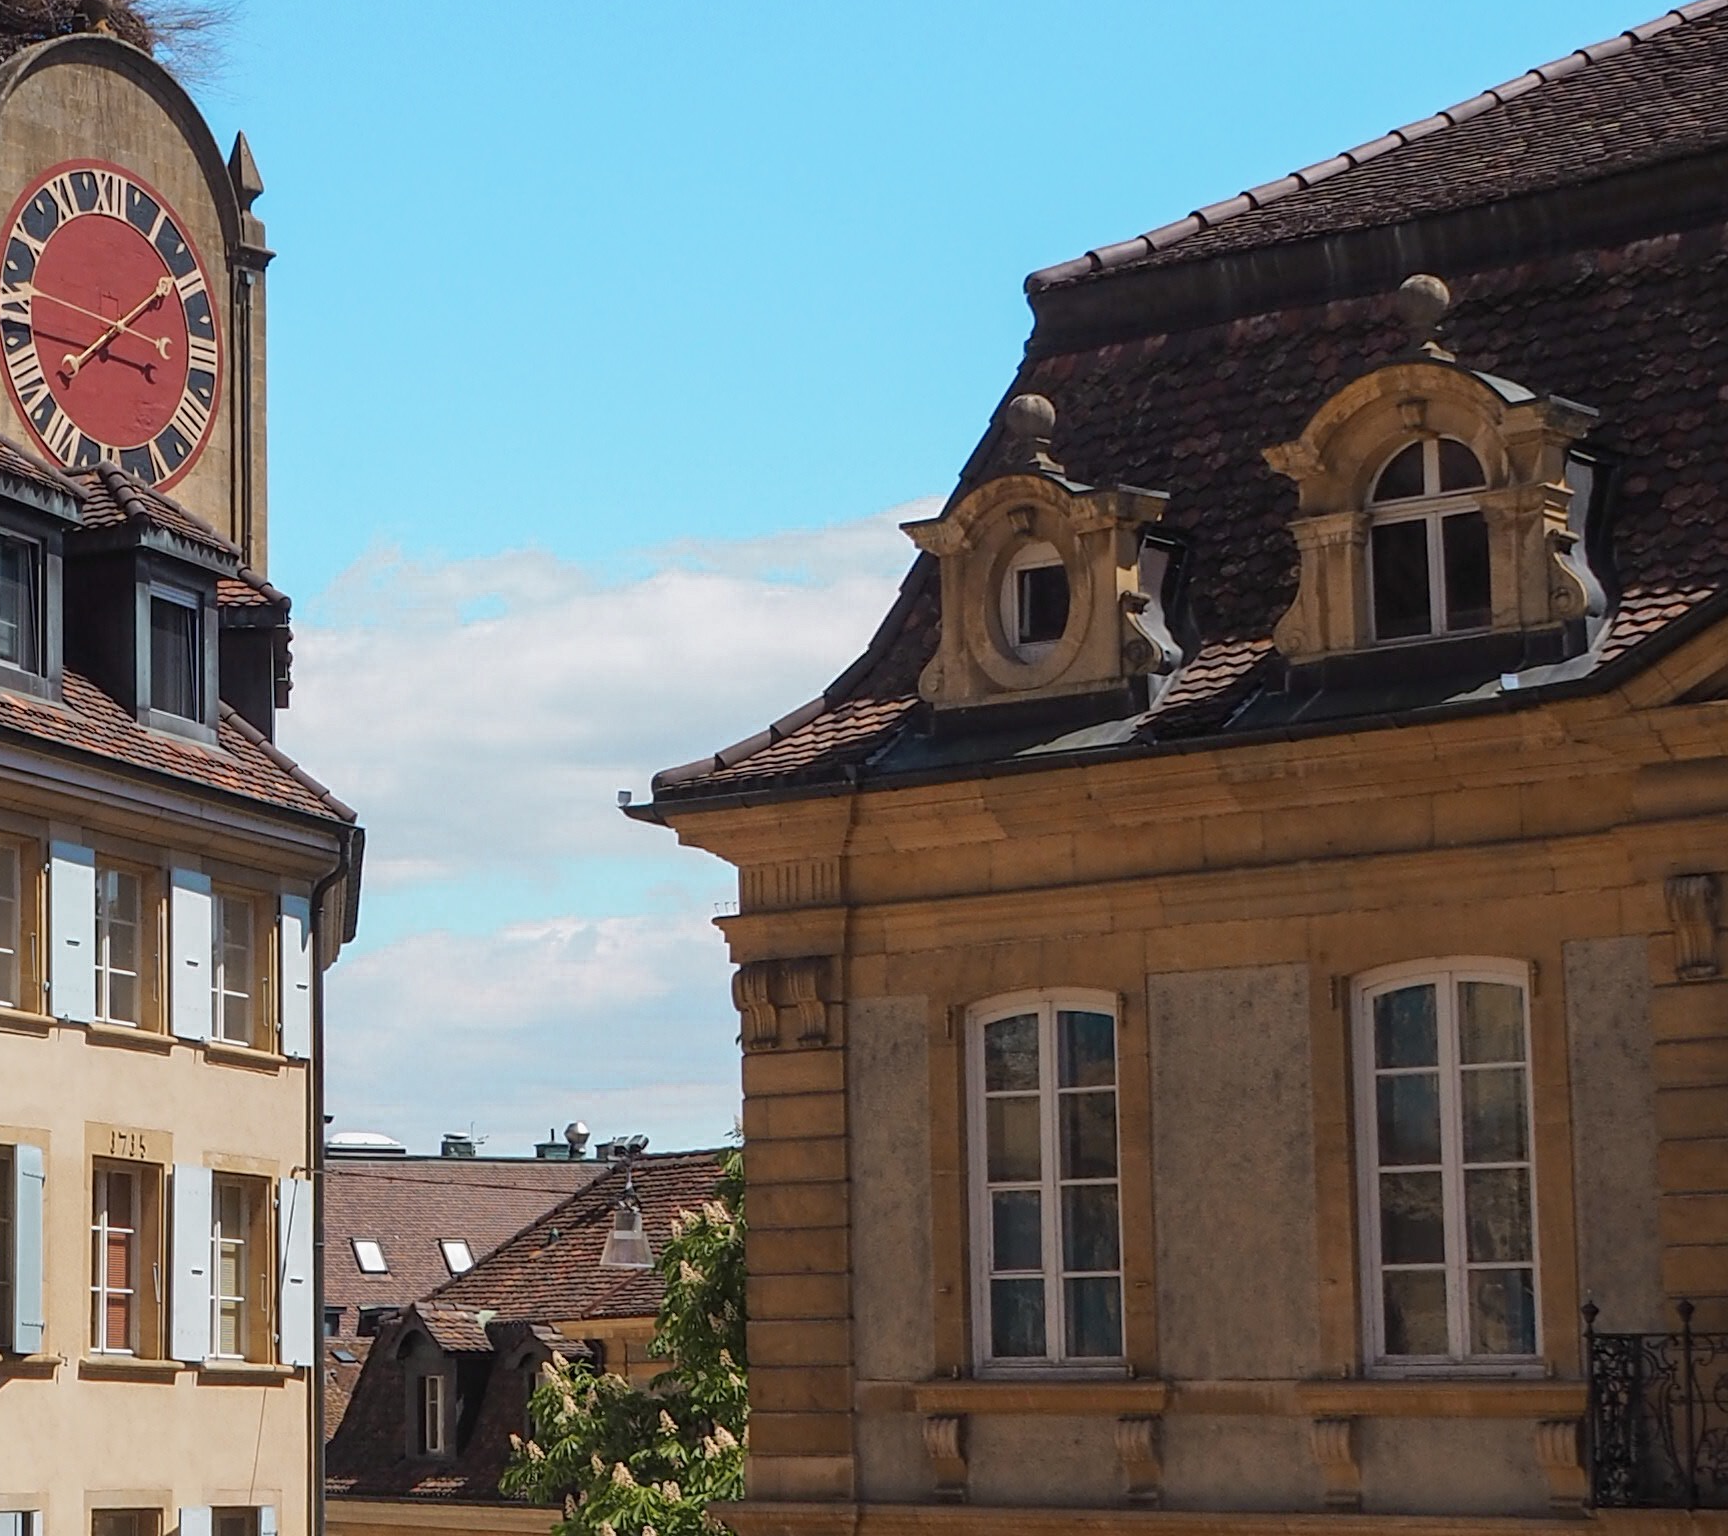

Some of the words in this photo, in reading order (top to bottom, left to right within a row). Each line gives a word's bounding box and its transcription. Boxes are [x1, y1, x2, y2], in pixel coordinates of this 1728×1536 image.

[95, 170, 127, 220] XII
[12, 218, 45, 258] X
[175, 269, 206, 303] II
[189, 335, 216, 367] III
